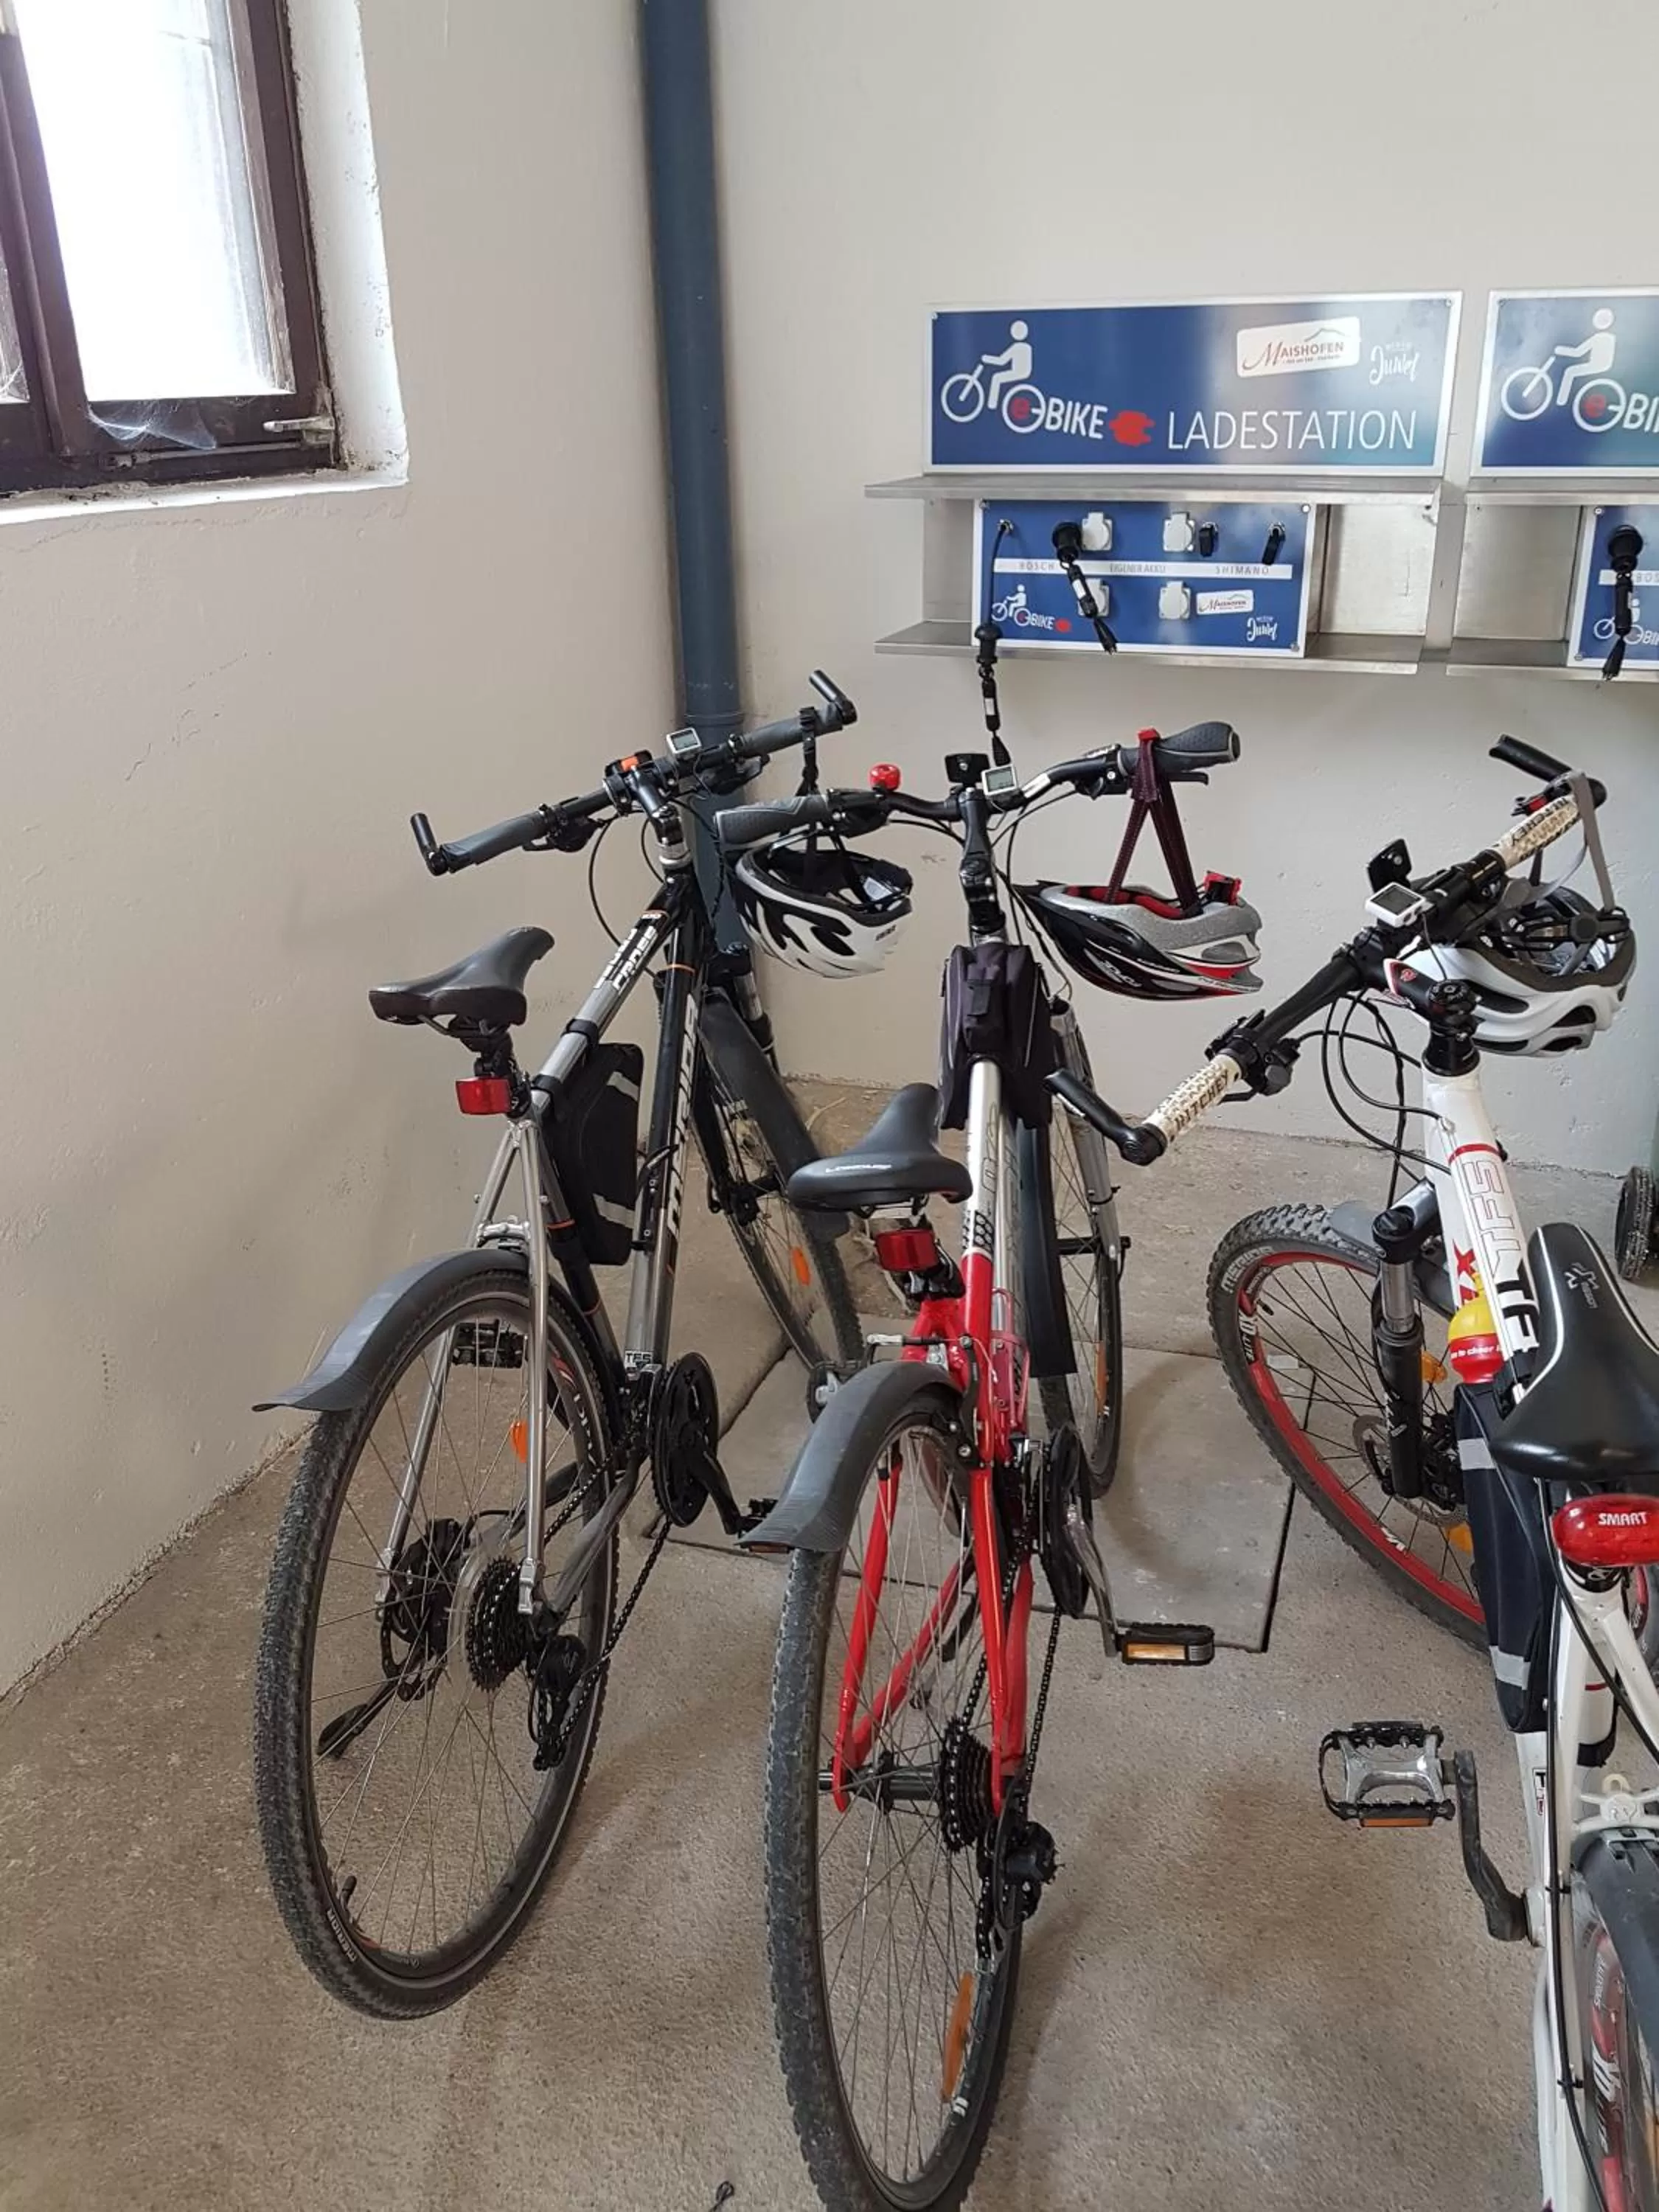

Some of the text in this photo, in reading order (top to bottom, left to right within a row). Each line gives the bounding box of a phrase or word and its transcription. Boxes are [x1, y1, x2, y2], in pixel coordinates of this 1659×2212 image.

[1242, 341, 1344, 371] MAISHOFEN
[1045, 397, 1108, 439] BIKE
[1168, 410, 1416, 450] LADESTATION
[1623, 392, 1659, 434] BI
[1215, 566, 1269, 574] SHIMANO
[1175, 1069, 1228, 1131] RITCHEY
[1462, 1161, 1521, 1278] TFS
[1598, 1512, 1648, 1526] SMART
